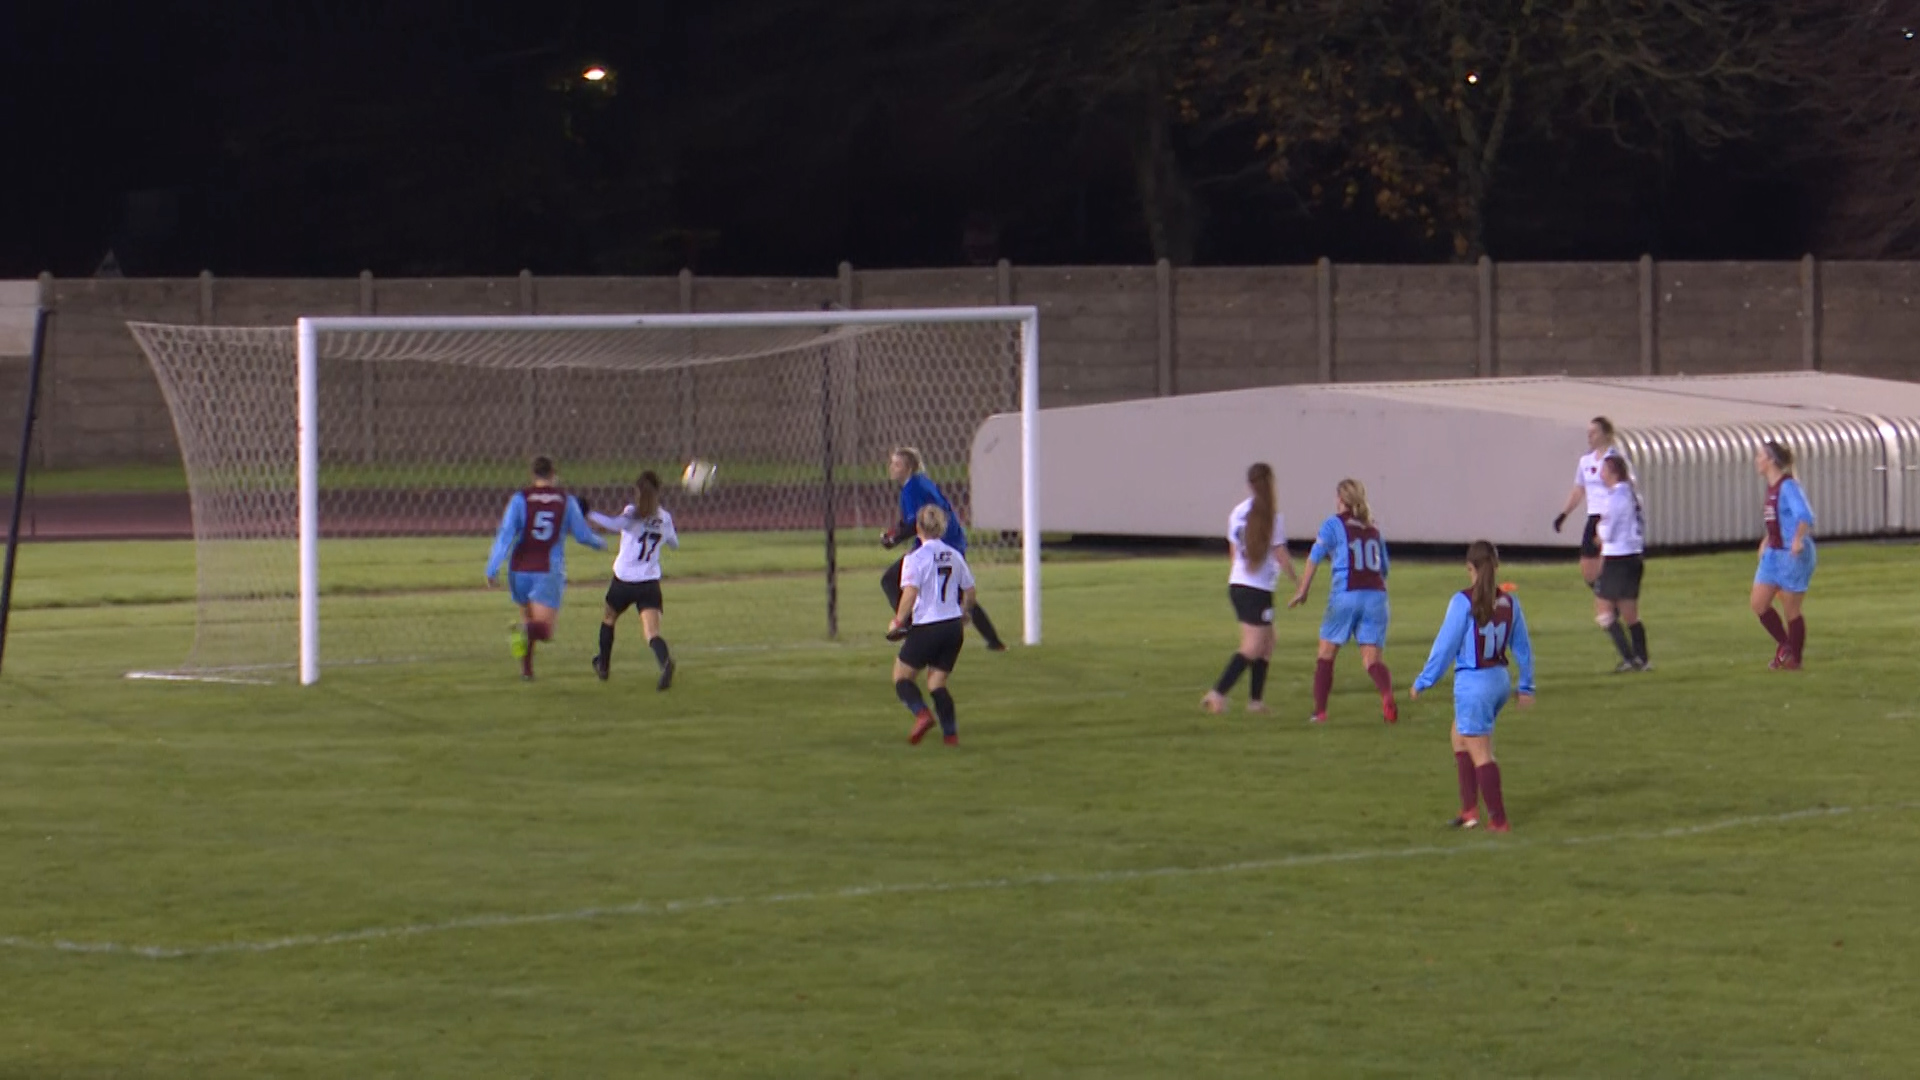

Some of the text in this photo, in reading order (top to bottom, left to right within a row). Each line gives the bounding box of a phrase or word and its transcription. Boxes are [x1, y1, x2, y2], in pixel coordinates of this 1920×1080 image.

[532, 511, 555, 541] 5
[638, 531, 662, 562] 17
[1349, 538, 1381, 571] 10
[937, 565, 952, 604] 7
[1479, 621, 1507, 659] 11
